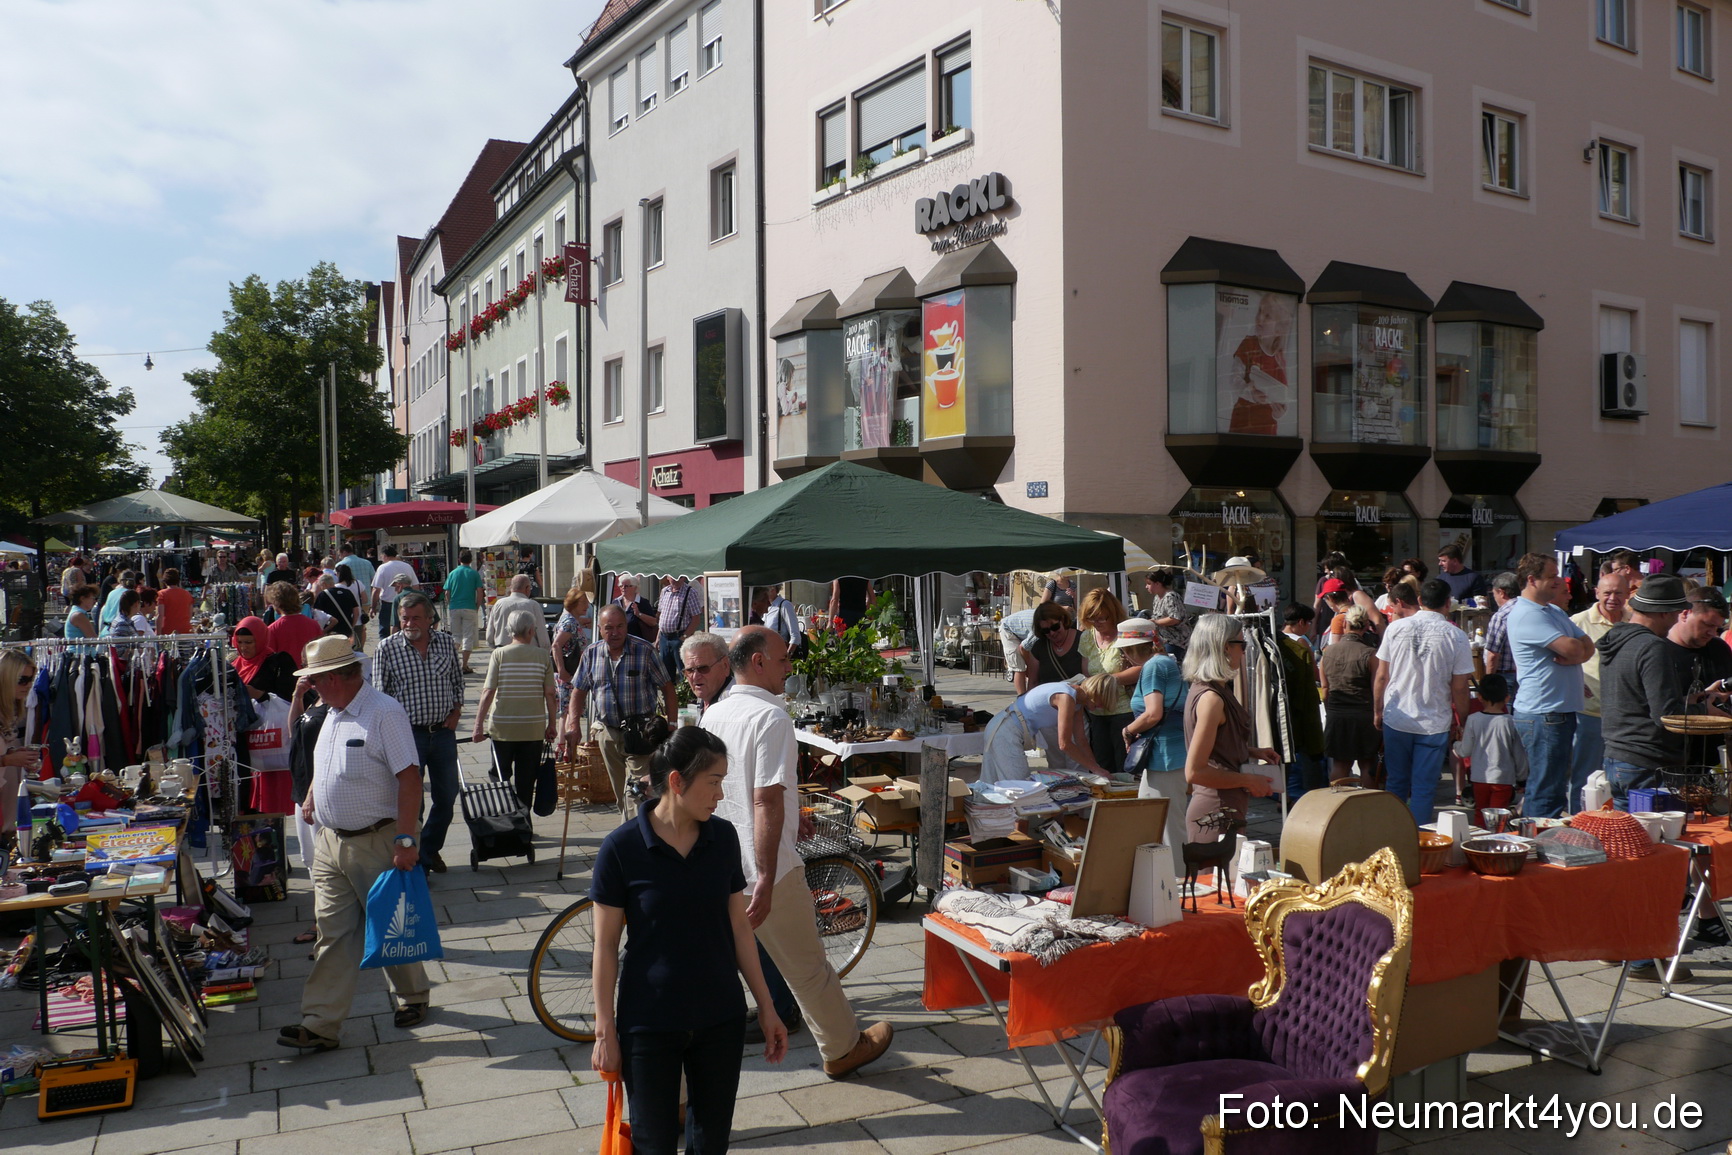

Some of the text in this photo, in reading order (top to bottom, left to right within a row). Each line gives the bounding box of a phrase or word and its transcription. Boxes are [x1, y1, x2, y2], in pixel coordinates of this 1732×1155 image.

[914, 171, 1007, 235] RACKL
[568, 254, 584, 300] Achatz
[1218, 291, 1249, 306] Thomas
[1378, 315, 1409, 326] 100 Jahre
[846, 332, 870, 358] RACKL
[1375, 326, 1404, 349] RACKL
[650, 463, 679, 488] Achatz
[426, 512, 454, 522] Achatz
[1222, 505, 1251, 525] RACKL
[1355, 505, 1381, 523] RACKL
[1472, 508, 1494, 524] RACKL
[248, 731, 276, 744] WITT
[99, 834, 165, 848] Electric
[131, 830, 157, 838] erstes
[381, 941, 428, 958] Kelheim
